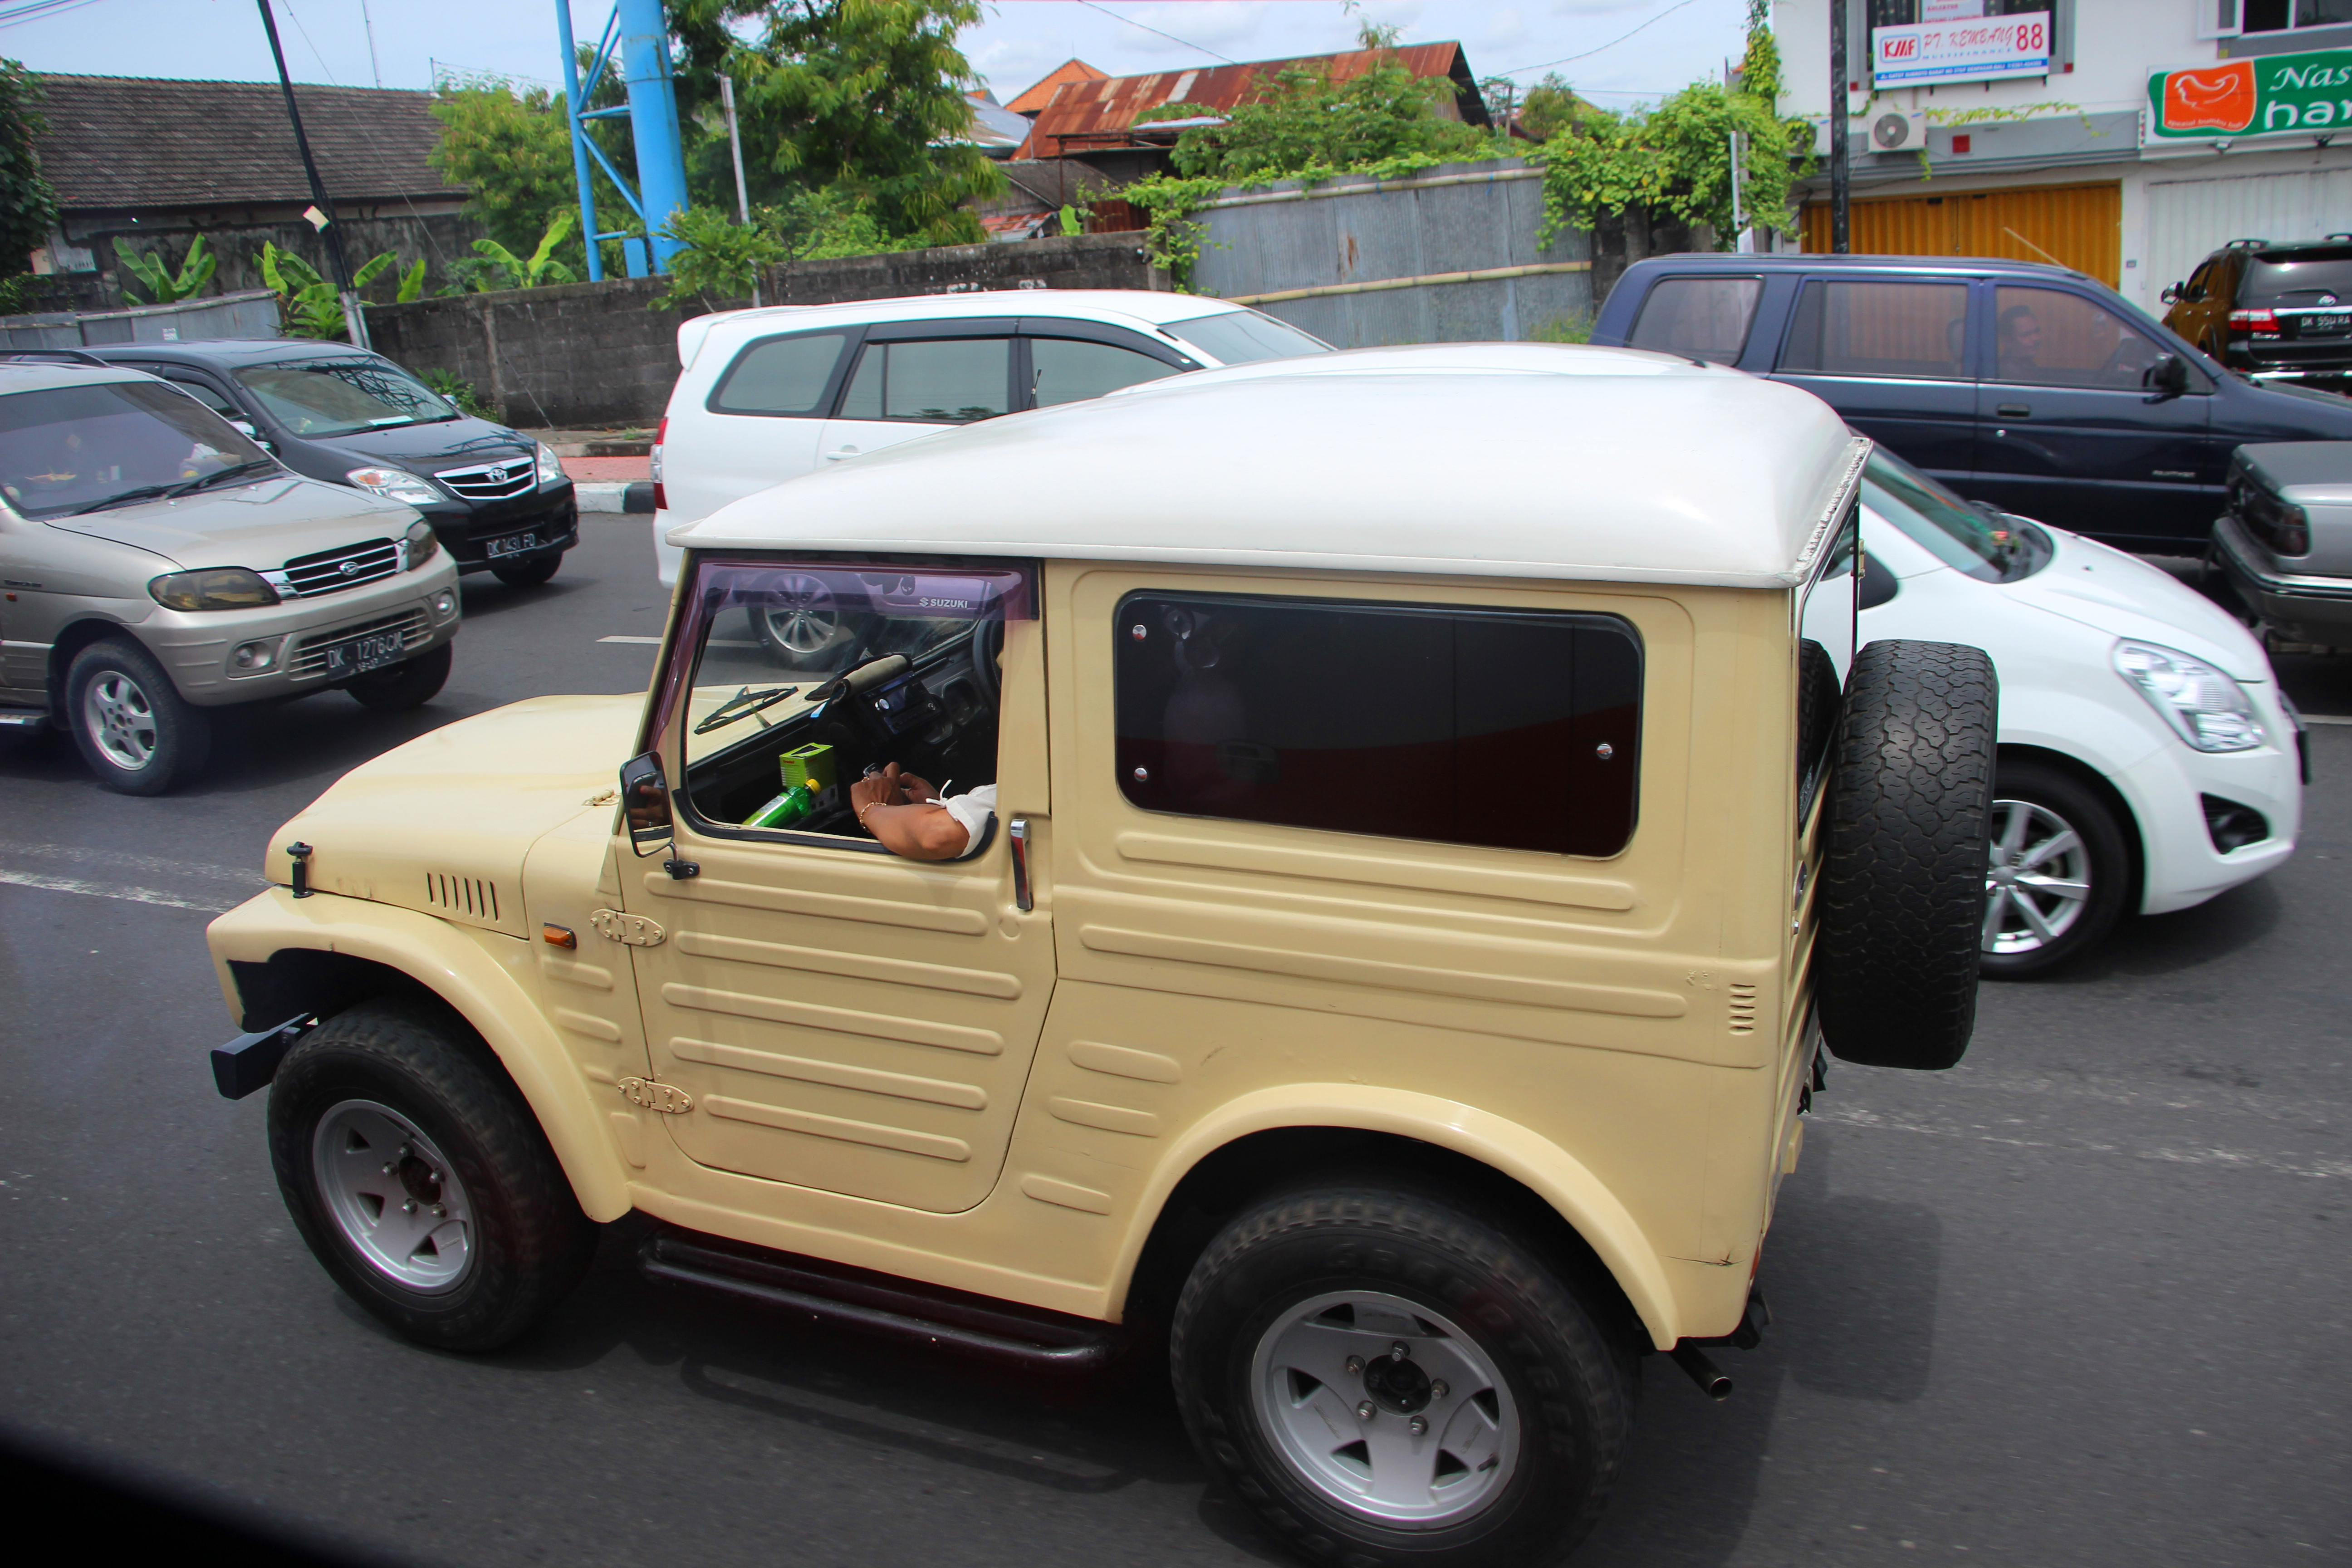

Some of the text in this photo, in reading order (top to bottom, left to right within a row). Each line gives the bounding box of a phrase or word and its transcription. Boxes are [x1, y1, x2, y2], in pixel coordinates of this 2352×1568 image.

[1950, 25, 2014, 48] KEMBANG
[2016, 23, 2043, 51] 88
[930, 598, 968, 608] SUZUKI
[328, 647, 345, 668] DK
